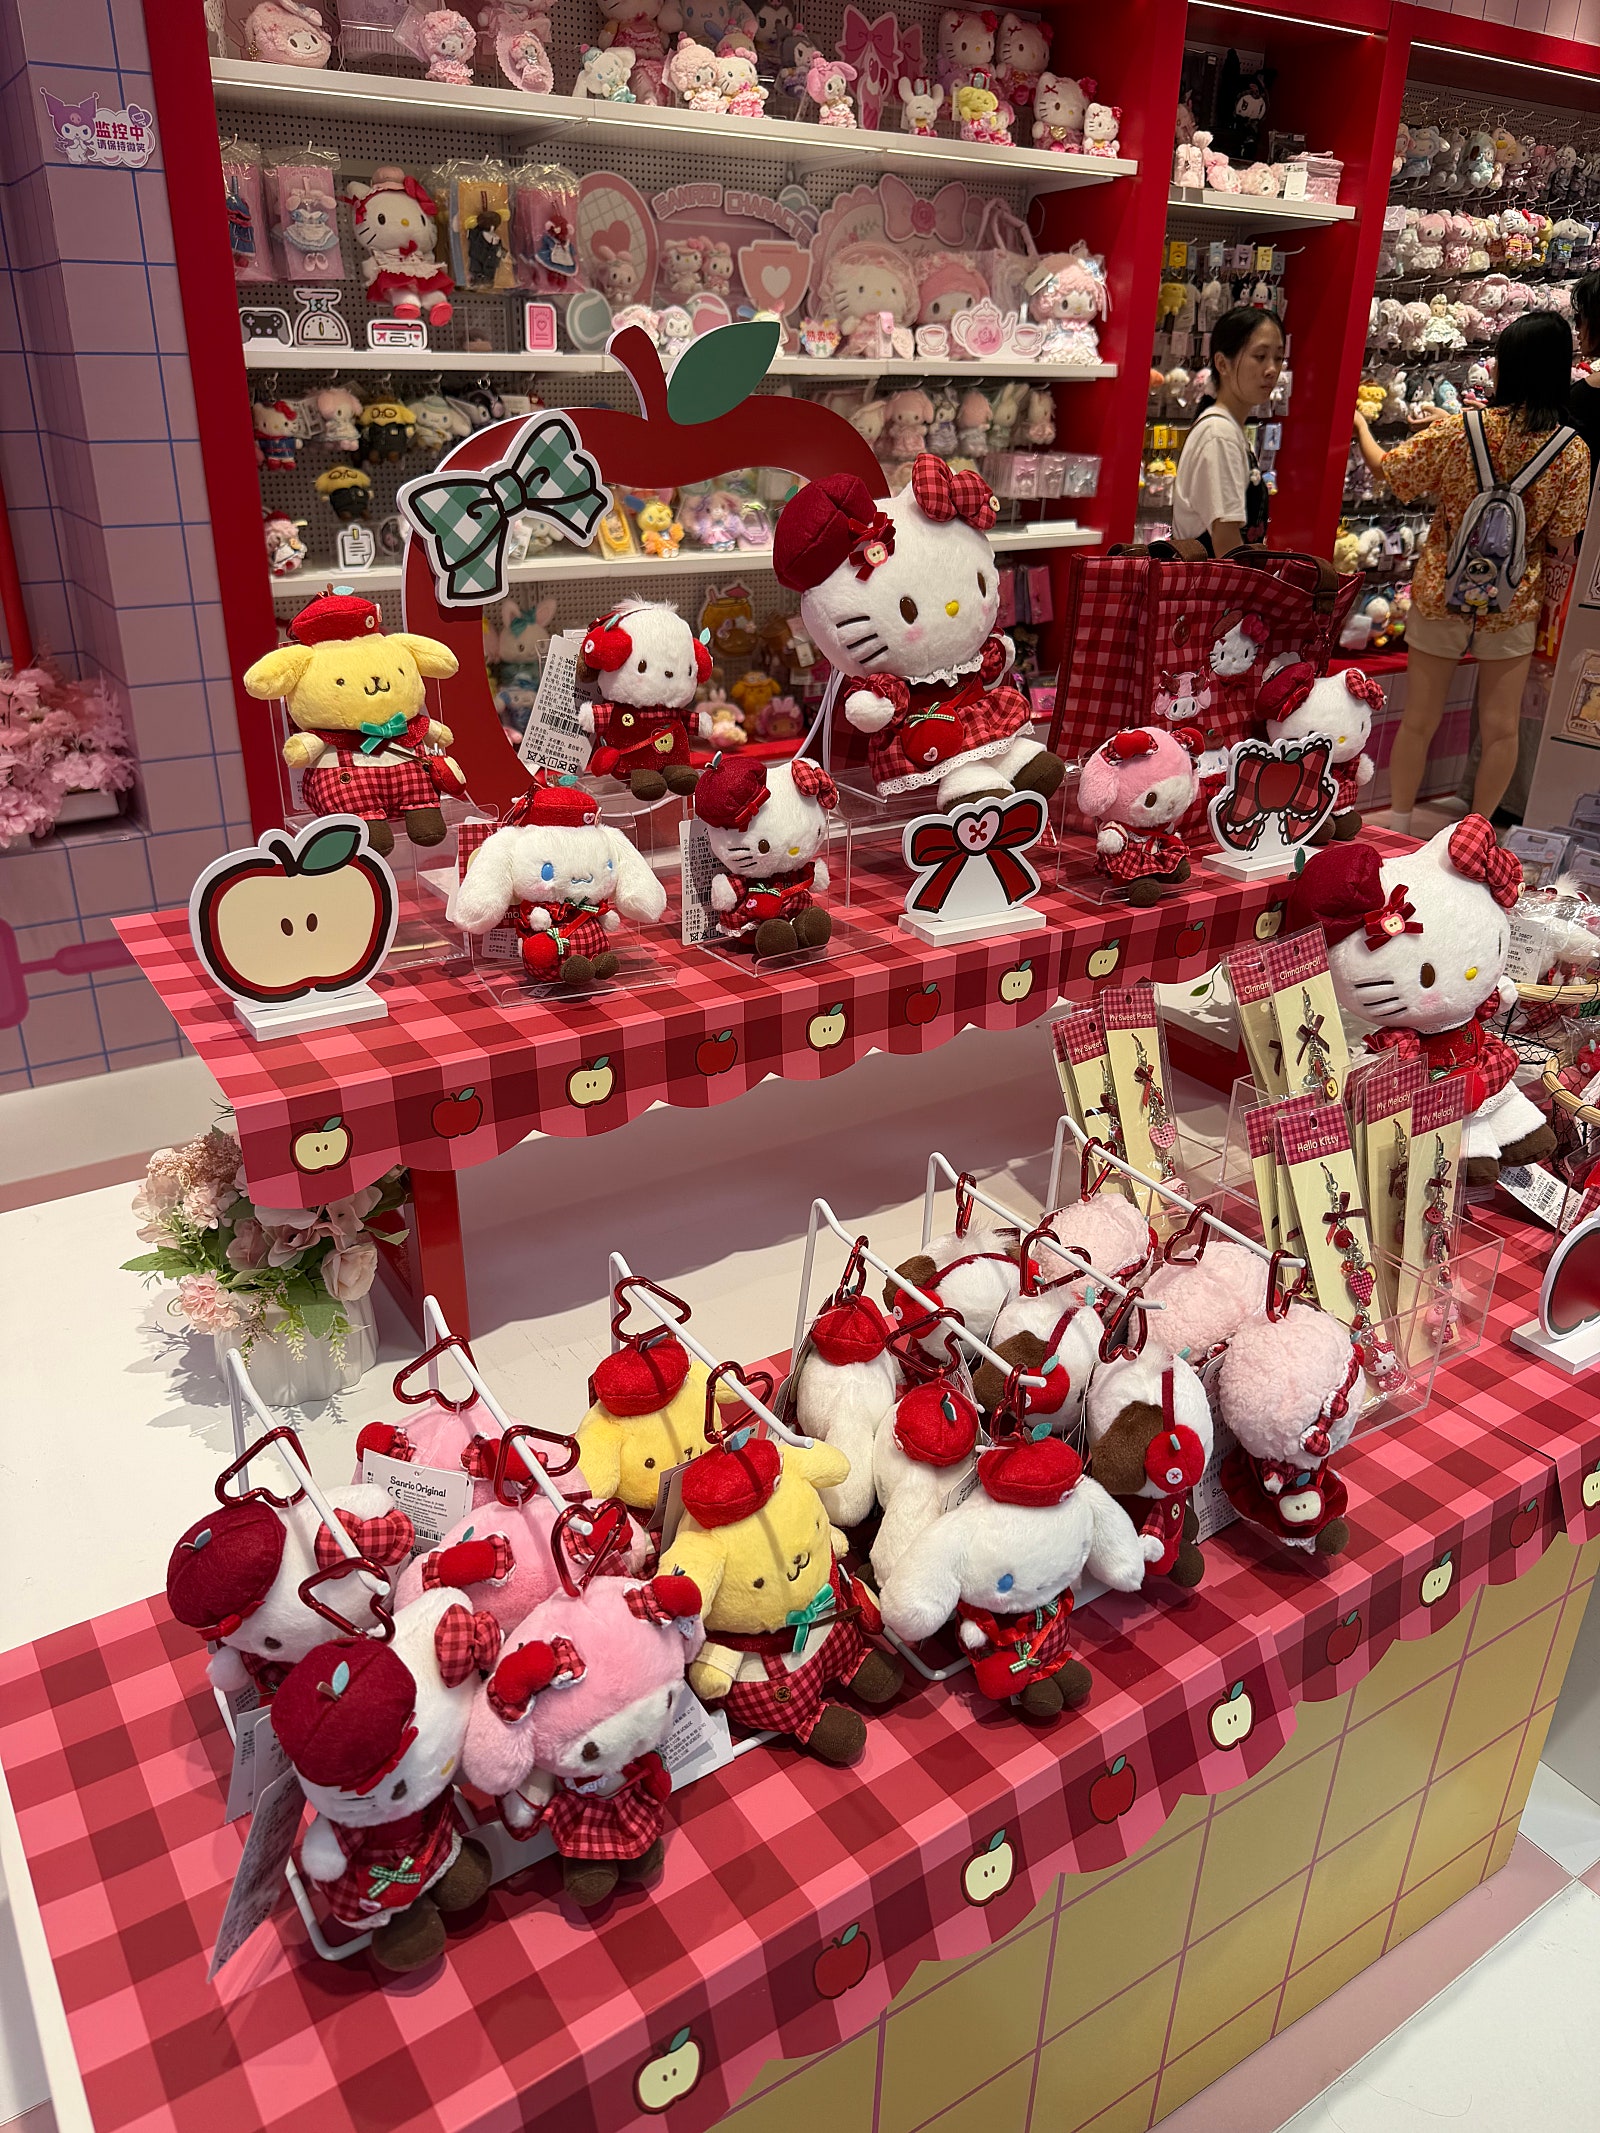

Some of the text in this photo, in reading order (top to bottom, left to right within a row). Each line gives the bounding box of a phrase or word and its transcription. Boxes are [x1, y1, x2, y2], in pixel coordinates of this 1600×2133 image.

[95, 121, 144, 141] 监控中
[97, 139, 146, 153] 请保持微笑
[652, 182, 816, 250] SANRIO CHARACTE
[1280, 956, 1321, 980] Cinnamoroll
[1244, 981, 1270, 995] Cinnam
[1119, 1013, 1136, 1021] Sweet
[1137, 1012, 1152, 1020] Piano
[1387, 1090, 1411, 1107] Melody
[1432, 1105, 1455, 1119] Melody
[1297, 1135, 1339, 1152] Hello Kitty
[390, 1475, 414, 1490] Sanrio
[415, 1482, 447, 1498] Original
